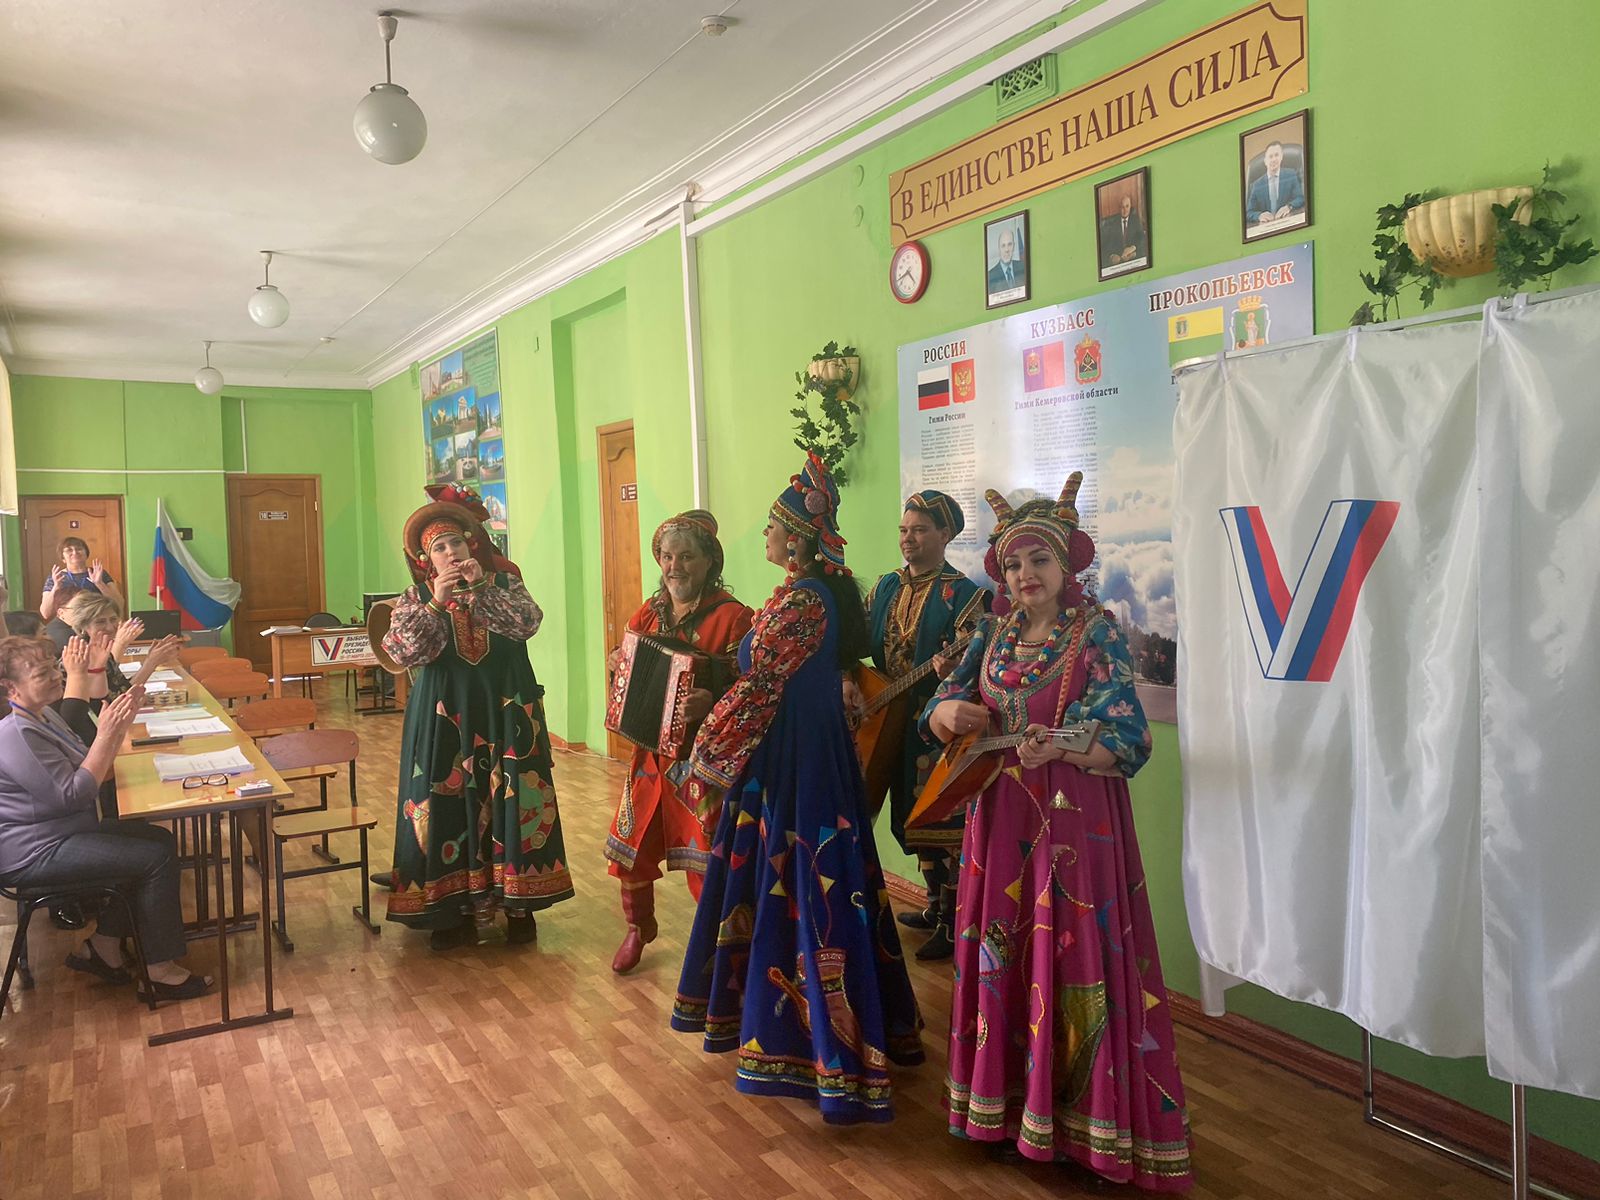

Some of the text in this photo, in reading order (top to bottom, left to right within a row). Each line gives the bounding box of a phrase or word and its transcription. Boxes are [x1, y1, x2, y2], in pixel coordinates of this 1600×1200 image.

[901, 30, 1281, 221] В ЕДИНСТВЕ НАША СИЛА
[1149, 261, 1294, 312] ПРОКОПЬЕВСК
[1031, 309, 1095, 339] КУЗБАСС
[923, 340, 966, 364] РОССИЯ
[1035, 391, 1085, 407] Кемеровской
[1085, 386, 1119, 399] области
[944, 412, 966, 422] России
